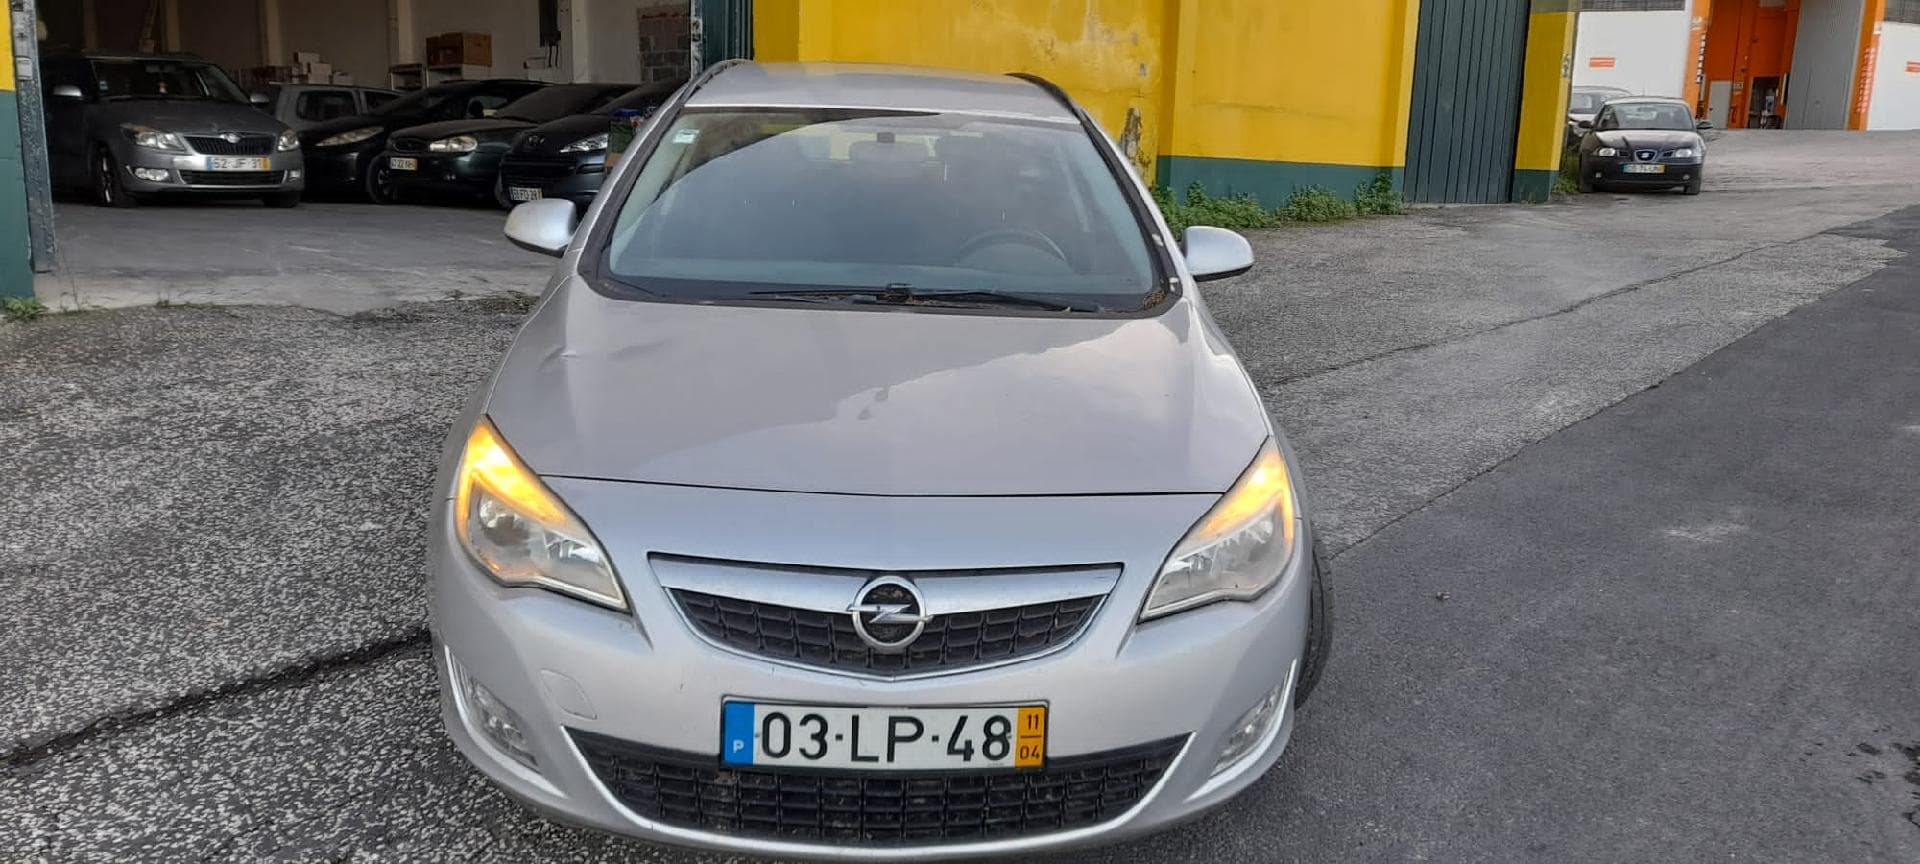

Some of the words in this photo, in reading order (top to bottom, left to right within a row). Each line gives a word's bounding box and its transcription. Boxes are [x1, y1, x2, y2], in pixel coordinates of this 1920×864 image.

[1028, 714, 1039, 730] 11
[733, 740, 745, 754] P
[1020, 745, 1040, 760] 04
